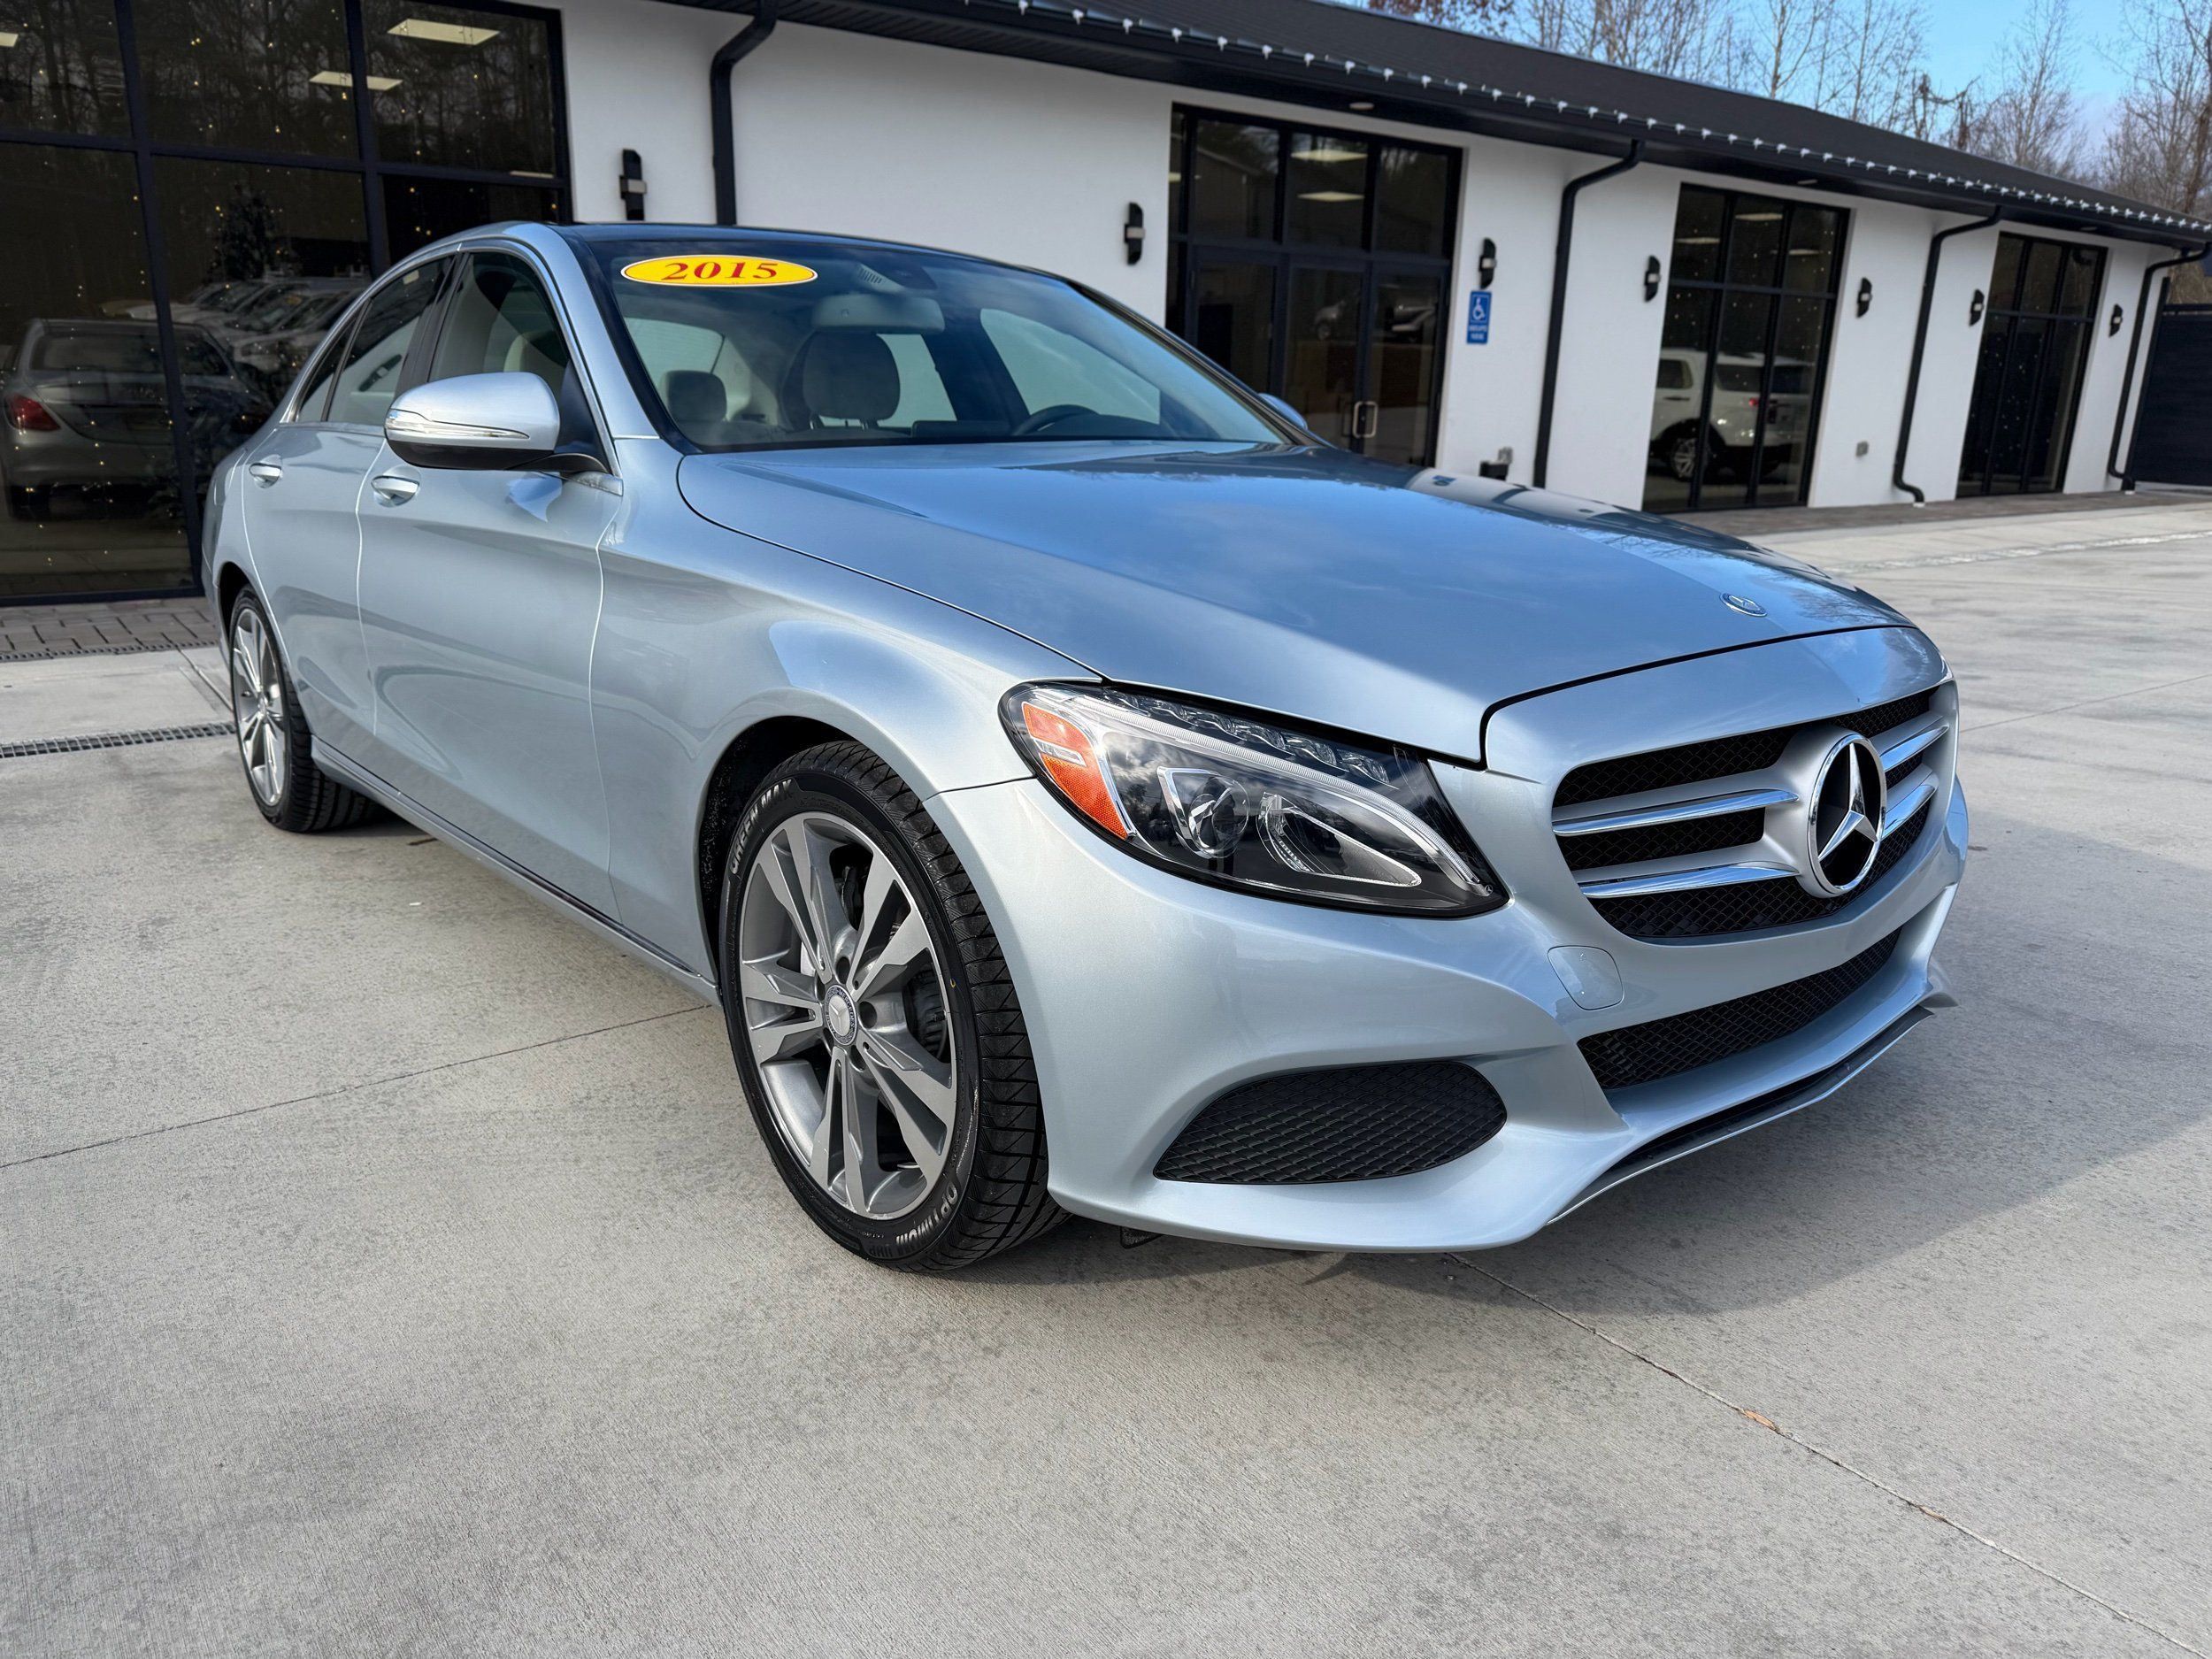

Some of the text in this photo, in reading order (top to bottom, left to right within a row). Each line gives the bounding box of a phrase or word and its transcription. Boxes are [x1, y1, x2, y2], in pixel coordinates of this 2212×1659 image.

[661, 261, 779, 280] 2015
[728, 779, 795, 875] GREEN MAX
